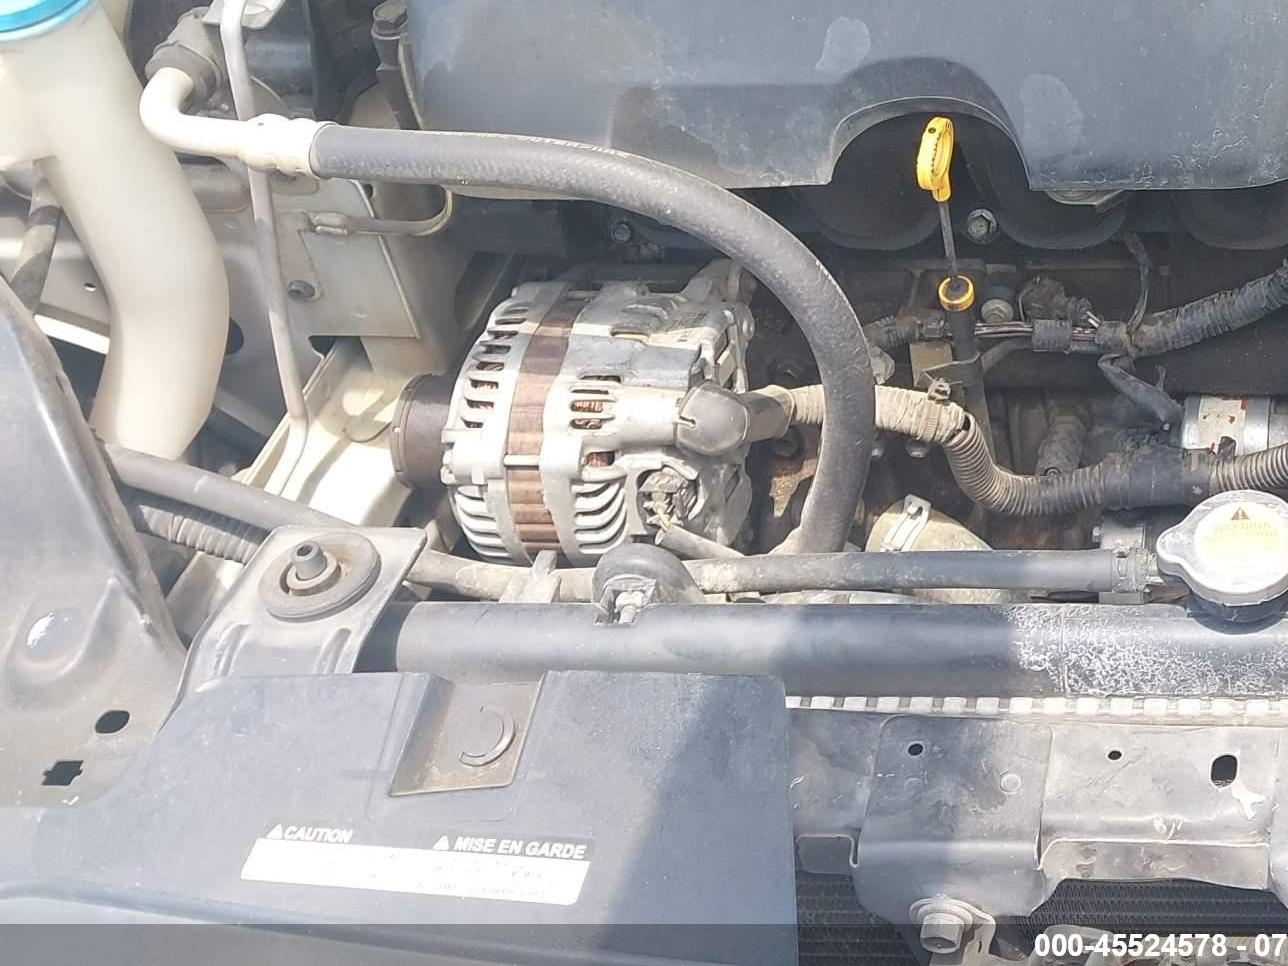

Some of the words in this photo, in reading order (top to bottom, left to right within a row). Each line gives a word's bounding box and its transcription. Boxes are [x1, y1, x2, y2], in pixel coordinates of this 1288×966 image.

[284, 825, 353, 843] CAUTION
[454, 836, 496, 853] MISE
[499, 839, 521, 855] EN
[525, 840, 586, 860] GARDE
